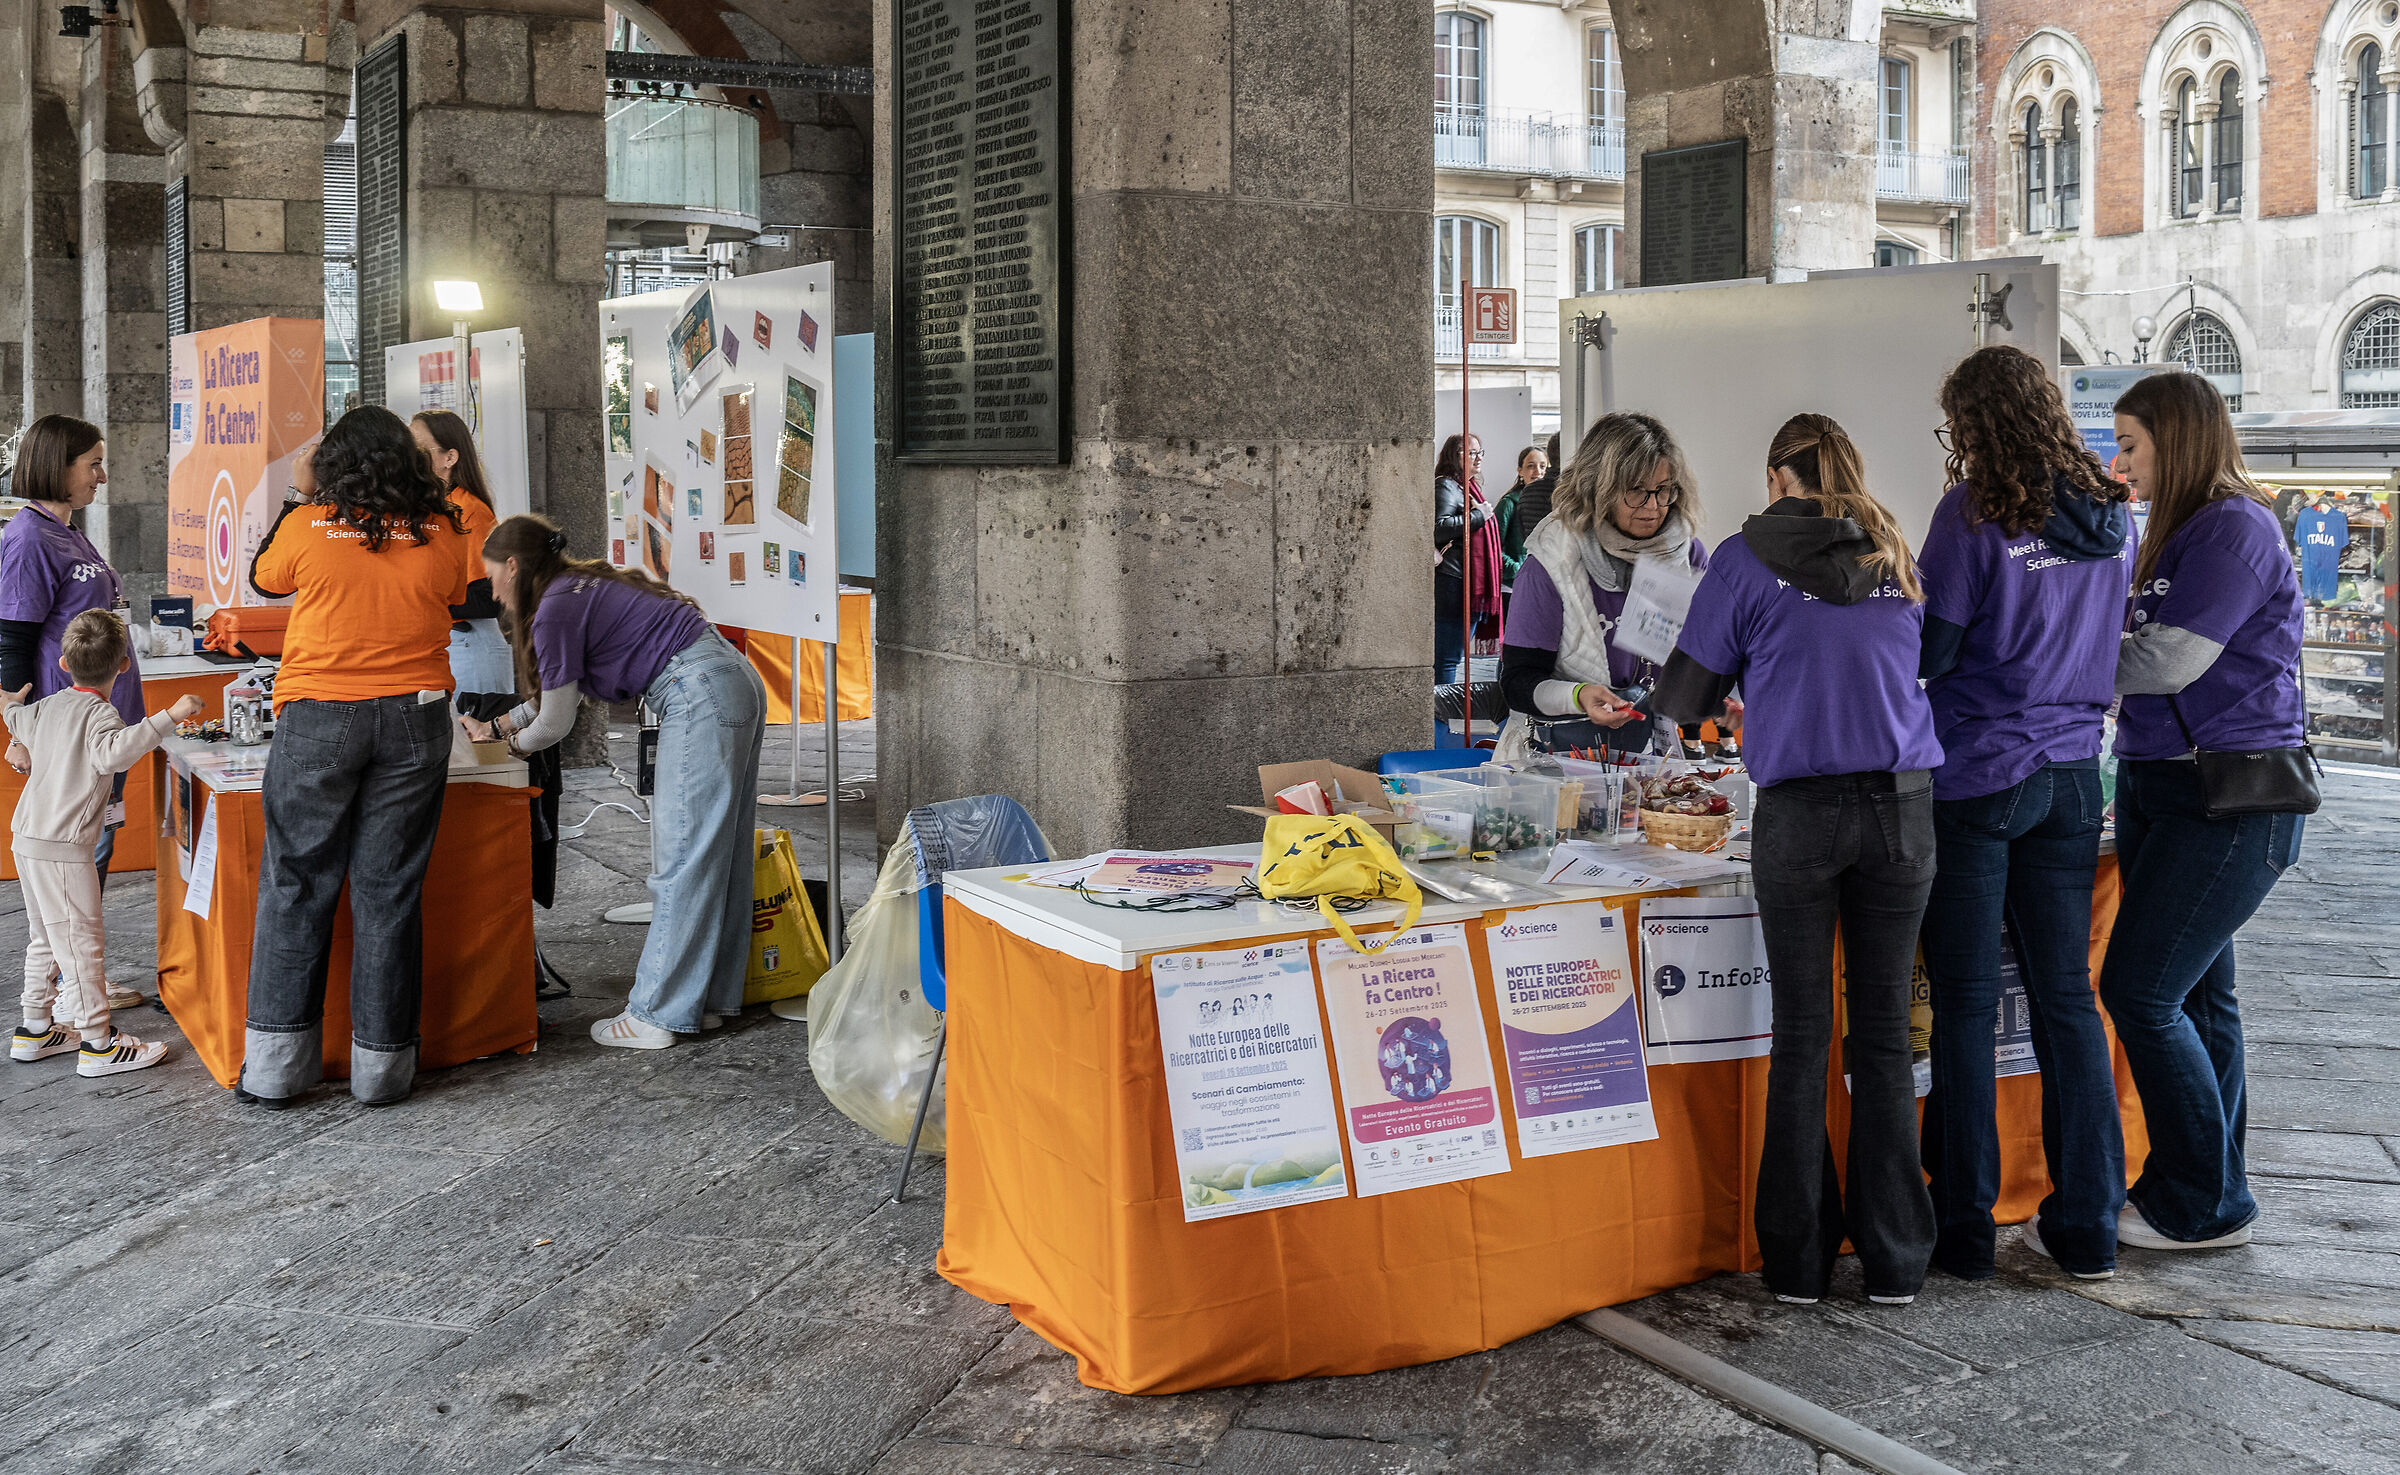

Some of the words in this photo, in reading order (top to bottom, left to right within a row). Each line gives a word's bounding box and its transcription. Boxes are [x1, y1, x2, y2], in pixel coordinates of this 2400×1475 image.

[205, 351, 216, 389] La
[219, 344, 259, 387] Ricerca
[205, 401, 215, 445] fa
[218, 402, 256, 445] Centro
[258, 401, 261, 443] !
[326, 529, 368, 540] Science
[2307, 533, 2335, 547] ITALIA
[2008, 542, 2037, 559] Meet
[1519, 923, 1558, 934] science
[1666, 923, 1709, 934] science
[1362, 973, 1380, 987] La
[1383, 967, 1435, 984] Ricerca
[1506, 964, 1544, 978] NOTTE
[1546, 959, 1600, 974] EUROPEA
[1248, 974, 1264, 983] Acque
[1507, 977, 1544, 991] DELLE
[1545, 969, 1621, 987] RICERCATRICI
[1698, 967, 1771, 989] InfoPo
[1366, 989, 1381, 1005] fa
[1384, 986, 1434, 1002] Centro
[1436, 982, 1441, 995] !
[1509, 992, 1517, 1003] E
[1520, 990, 1539, 1002] DEI
[1542, 982, 1615, 1000] RICERCATORI
[1365, 1009, 1387, 1018] 26-27
[1390, 1004, 1429, 1015] Settembre
[1431, 1000, 1448, 1009] 2025
[1512, 1007, 1530, 1015] 26-27
[1532, 1003, 1570, 1013] SETTEMBRE
[1571, 1001, 1587, 1009] 2025
[1189, 1033, 1216, 1048] Notte
[1218, 1027, 1261, 1045] Europea
[1263, 1023, 1290, 1039] delle
[1170, 1047, 1228, 1067] Ricercatrici
[1231, 1049, 1237, 1060] e
[1239, 1043, 1256, 1059] dei
[1258, 1034, 1318, 1056] Ricercatori
[1559, 1043, 1586, 1051] esperimenti,
[1579, 1047, 1605, 1055] condivisione
[2000, 1047, 2025, 1057] science
[1236, 1063, 1271, 1076] Settembre
[1271, 1060, 1288, 1071] 2025
[1192, 1089, 1225, 1100] Scenari
[1226, 1087, 1234, 1096] di
[1236, 1078, 1305, 1094] Cambiamento:
[1201, 1099, 1227, 1111] viaggio
[1228, 1096, 1248, 1107] negli
[1249, 1091, 1291, 1103] ecosistemi
[1221, 1103, 1280, 1117] trasformazione
[1414, 1103, 1443, 1112] Ricercatrici
[1385, 1122, 1421, 1136] Evento
[1424, 1115, 1467, 1130] Gratuito
